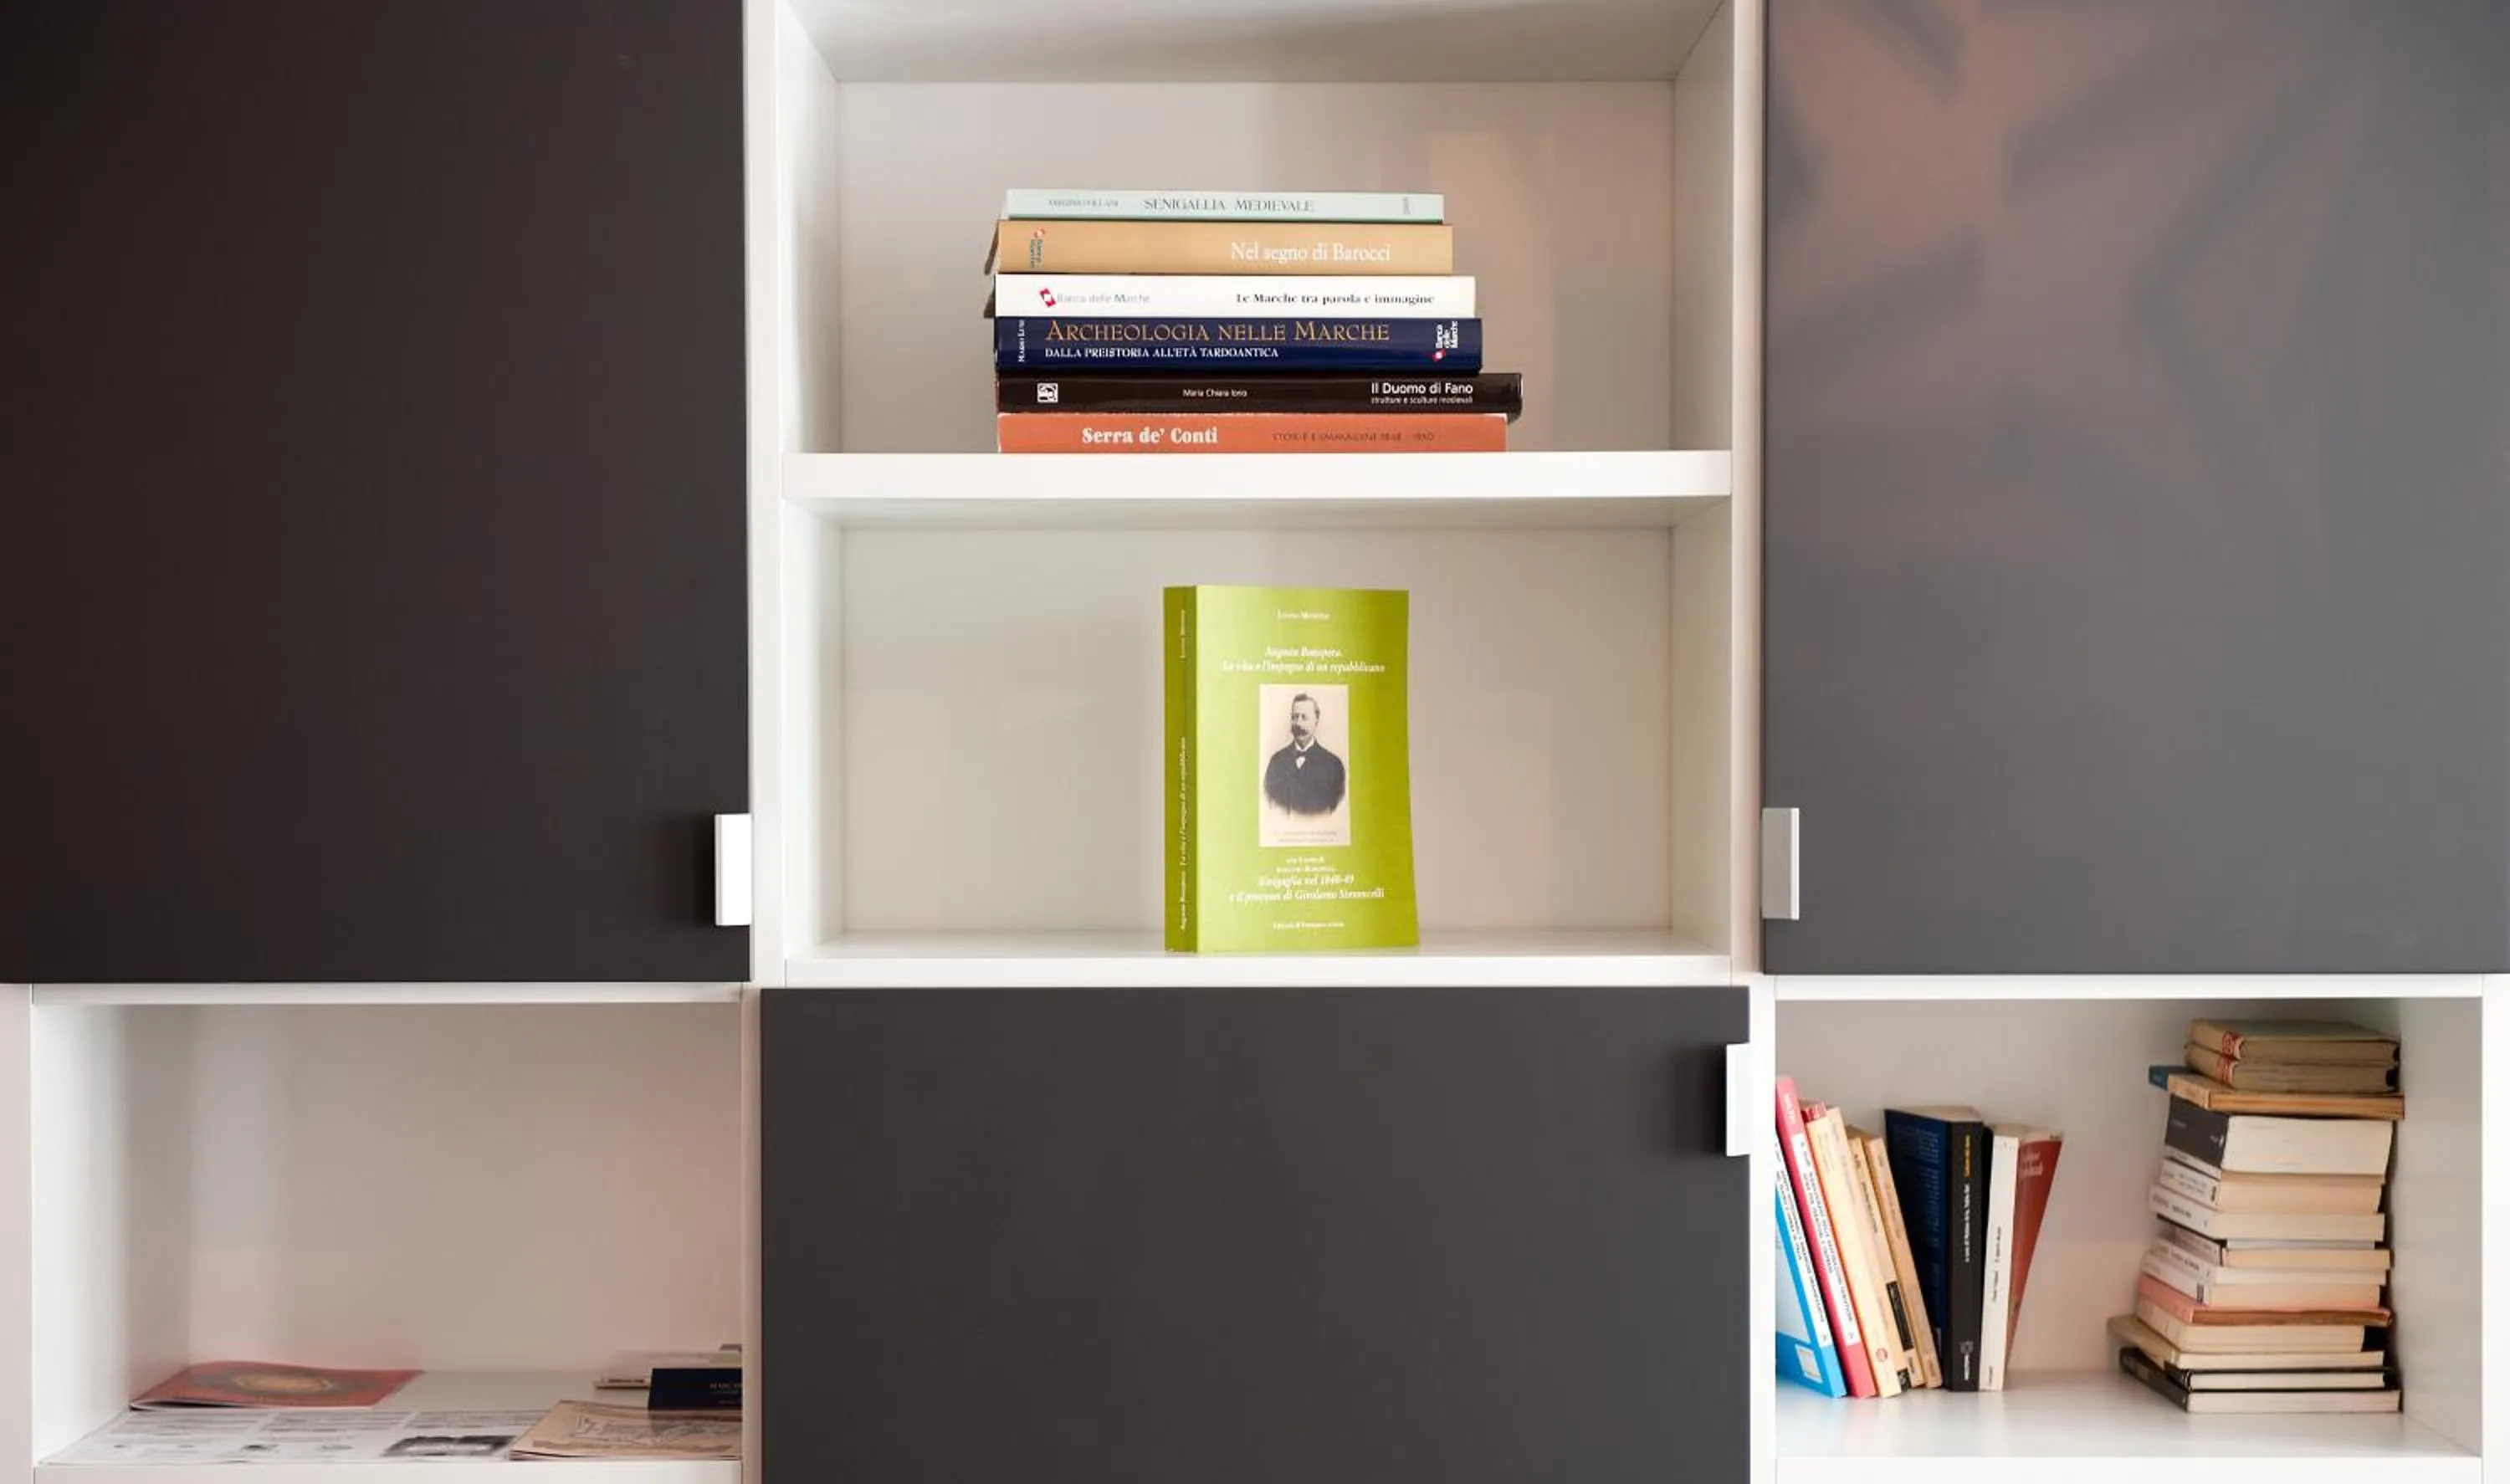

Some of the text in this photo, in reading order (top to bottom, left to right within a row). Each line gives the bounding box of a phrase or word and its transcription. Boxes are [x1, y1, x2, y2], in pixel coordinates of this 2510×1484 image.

[1143, 198, 1314, 212] SENIGALLIA MEDIEVALE
[1230, 241, 1391, 264] Nel segno di Barocci
[1114, 293, 1150, 304] Marche
[1236, 294, 1435, 307] Le Marche tra parola e immagine
[1047, 320, 1391, 342] ARCHEOLOGIA NELLE MARCHE
[1450, 320, 1458, 349] Marche
[1046, 345, 1279, 358] DALLA PREISTORIA ALL'ETÀ TARDOANTICA
[1182, 388, 1204, 398] Maria
[1206, 388, 1230, 398] Chiara
[1371, 382, 1473, 395] Il Duomo di Fano
[1082, 427, 1133, 444] Serra
[1170, 427, 1218, 444] Conti
